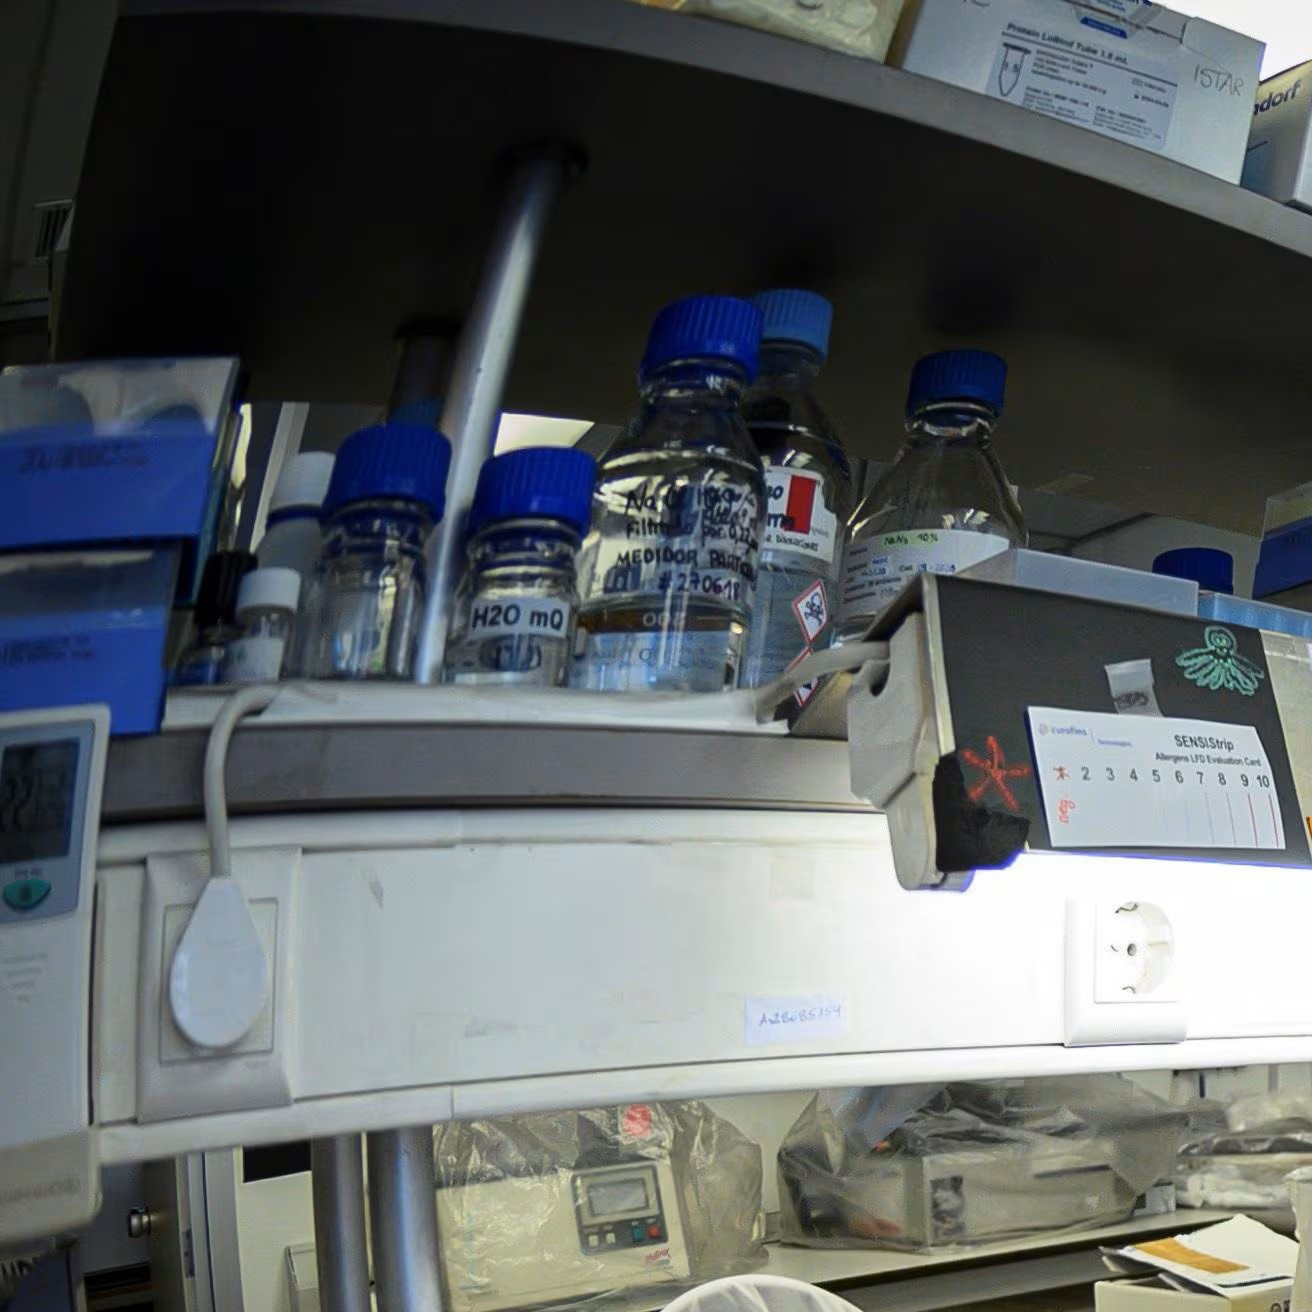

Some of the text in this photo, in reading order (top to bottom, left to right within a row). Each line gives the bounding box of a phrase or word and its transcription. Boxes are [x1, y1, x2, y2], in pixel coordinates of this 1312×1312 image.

[1194, 65, 1244, 97] ISTAR
[616, 548, 698, 570] MEDIDOR
[472, 604, 563, 631] H2O mQ
[1174, 734, 1234, 752] SENSIStrip
[1081, 767, 1270, 789] 2 3 4 5 6 7 8 9 10
